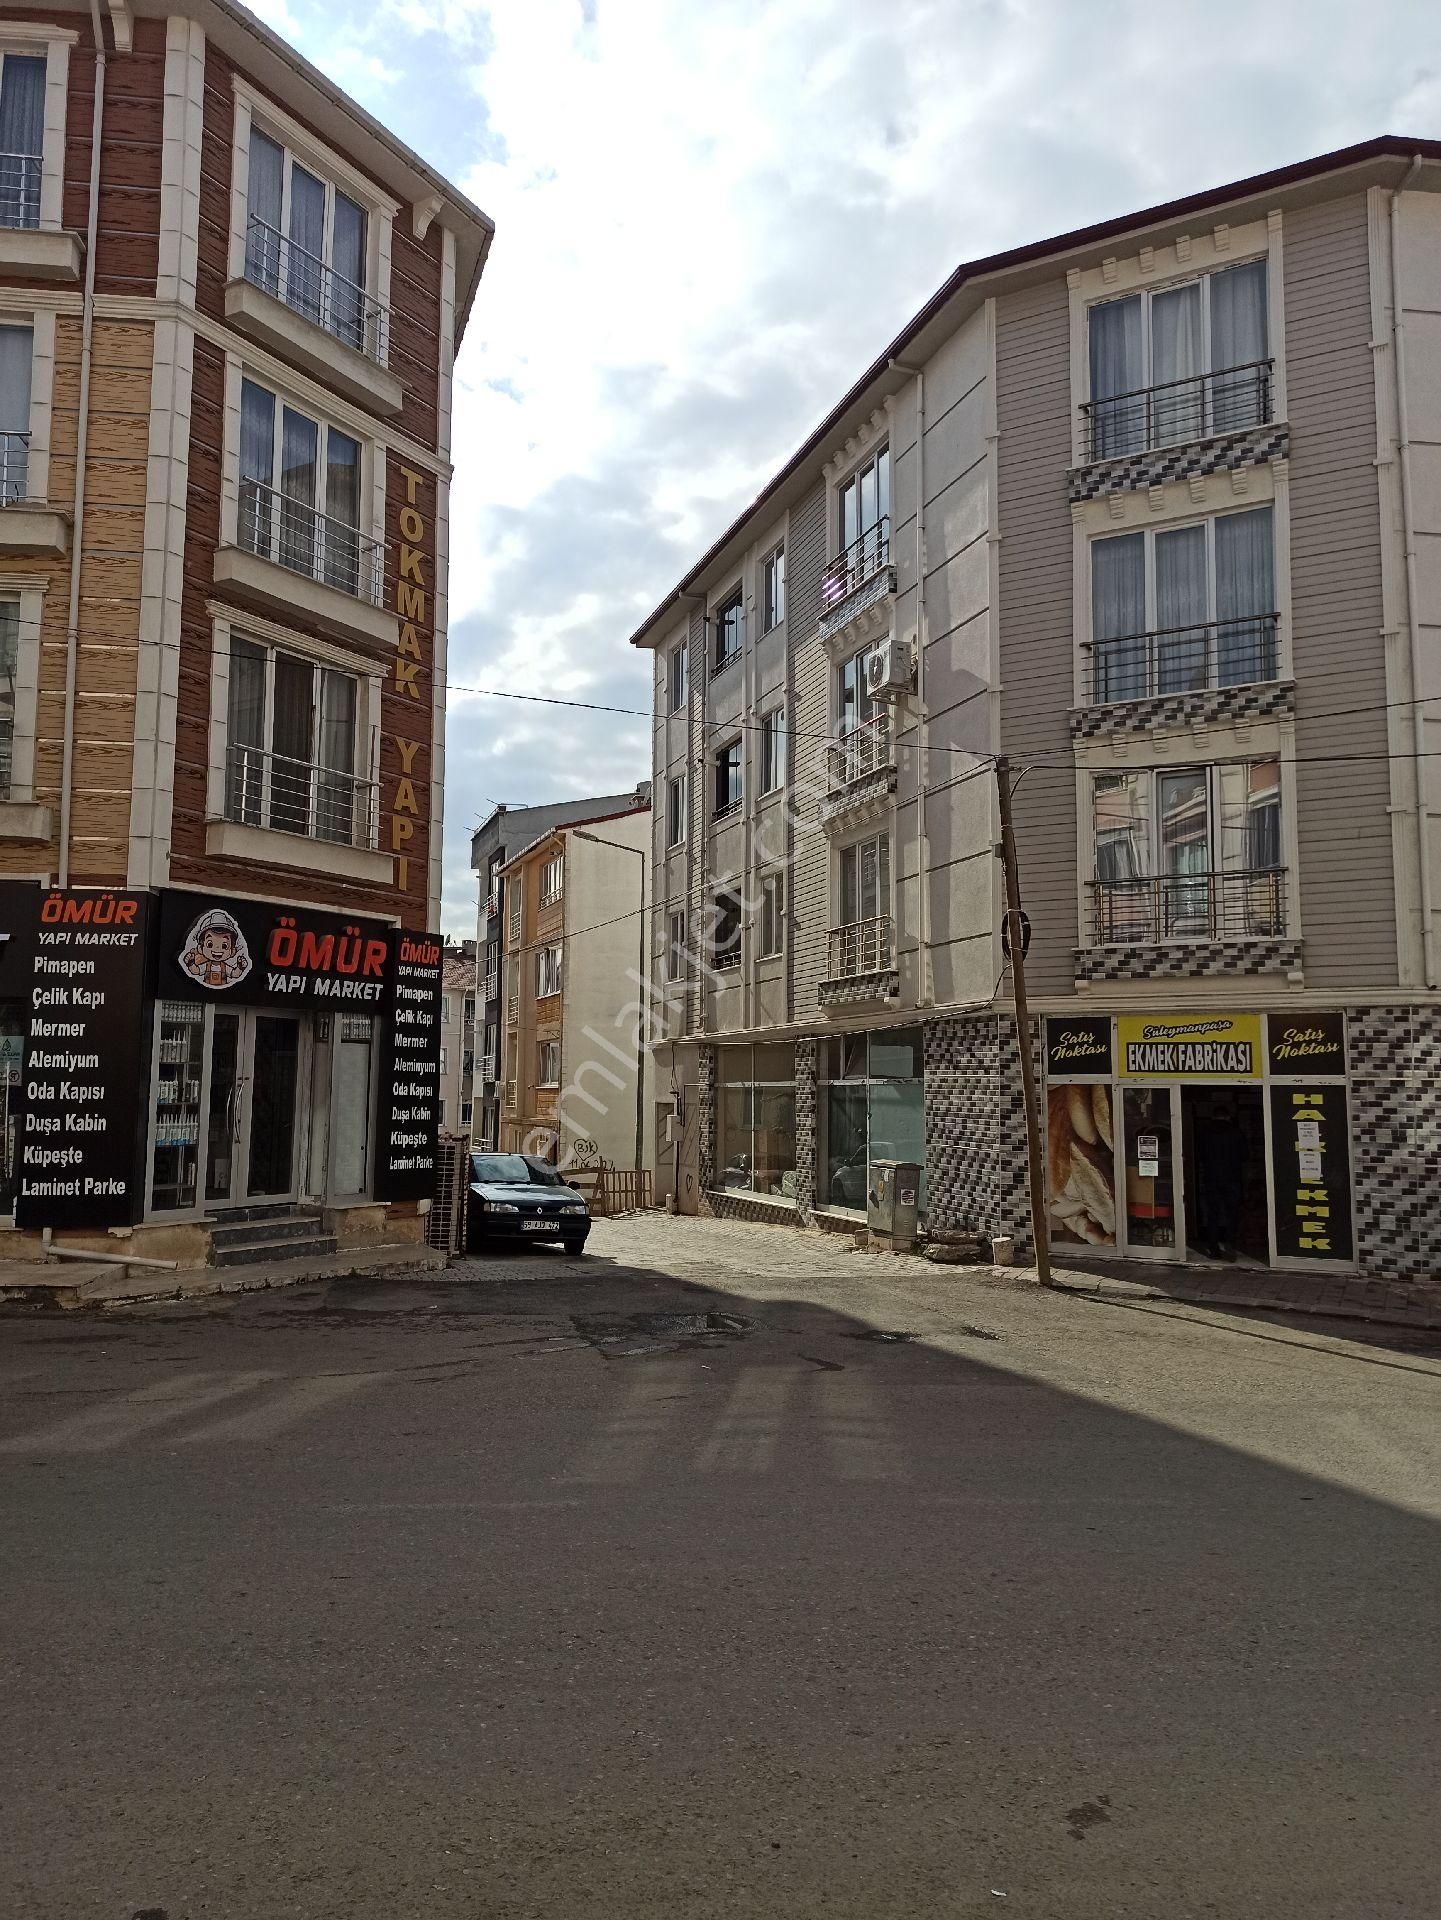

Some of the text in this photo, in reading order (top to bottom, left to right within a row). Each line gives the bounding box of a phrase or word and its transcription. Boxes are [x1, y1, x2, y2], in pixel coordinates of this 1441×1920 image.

[391, 467, 425, 891] TOKMAK YAPI
[41, 893, 138, 924] ÖMÜR
[38, 932, 139, 946] YAPI MARKET
[269, 916, 388, 977] ÖMÜR
[400, 937, 440, 966] ÖMÜR
[33, 956, 95, 978] Pimapen
[397, 965, 440, 979] YAPI MARKET
[267, 972, 384, 1001] YAPI MARKET
[396, 984, 434, 1003] Pimapen
[32, 987, 105, 1009] Çelik Kapı
[30, 1018, 86, 1037] Mermer
[395, 1008, 434, 1028] Çelik Kapı
[394, 1032, 428, 1048] Mermer
[1060, 1031, 1096, 1047] Satış
[1282, 1028, 1326, 1045] Satış
[1050, 1043, 1108, 1061] Noktası
[1128, 1044, 1174, 1071] EKMEK
[1272, 1042, 1340, 1060] Noktası
[28, 1050, 99, 1073] Alemiyum
[27, 1081, 105, 1104] Oda Kapısı
[392, 1082, 433, 1100] Oda Kapısı
[25, 1113, 107, 1136] Duşa Kabin
[391, 1106, 431, 1124] Duşa Kabin
[390, 1131, 428, 1149] Küpeşte
[23, 1145, 83, 1168] Küpeşte
[389, 1155, 434, 1170] Laminet Parke
[21, 1177, 126, 1196] Laminet Parke
